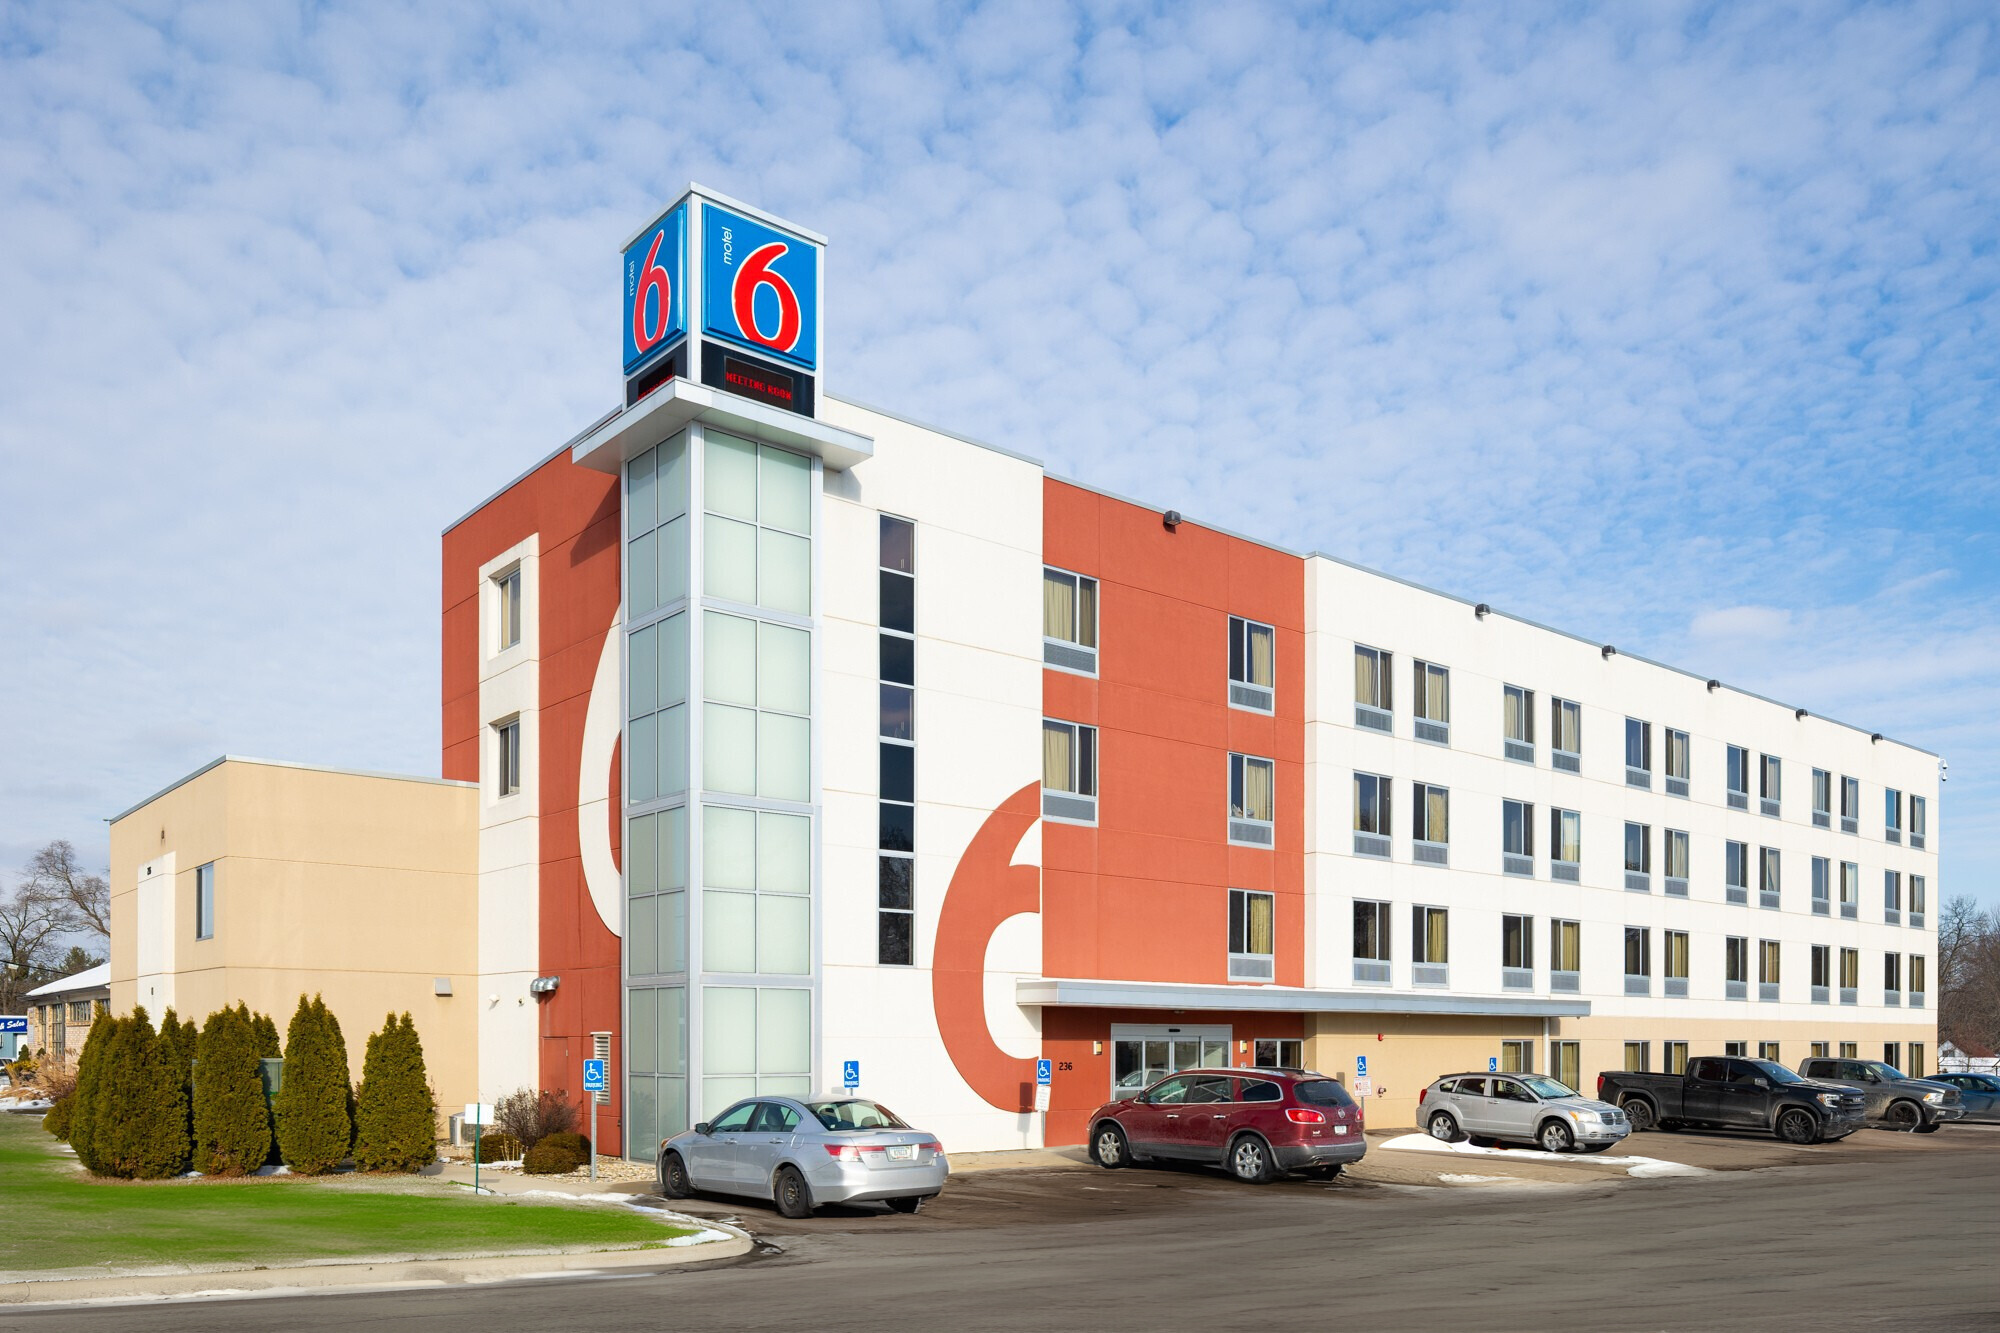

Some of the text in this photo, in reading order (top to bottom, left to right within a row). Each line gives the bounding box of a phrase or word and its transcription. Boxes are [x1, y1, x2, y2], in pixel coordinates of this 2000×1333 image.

[633, 229, 671, 354] 6
[722, 227, 802, 353] motel 6
[725, 371, 792, 400] MEETING ROOM
[1058, 1062, 1073, 1071] 236
